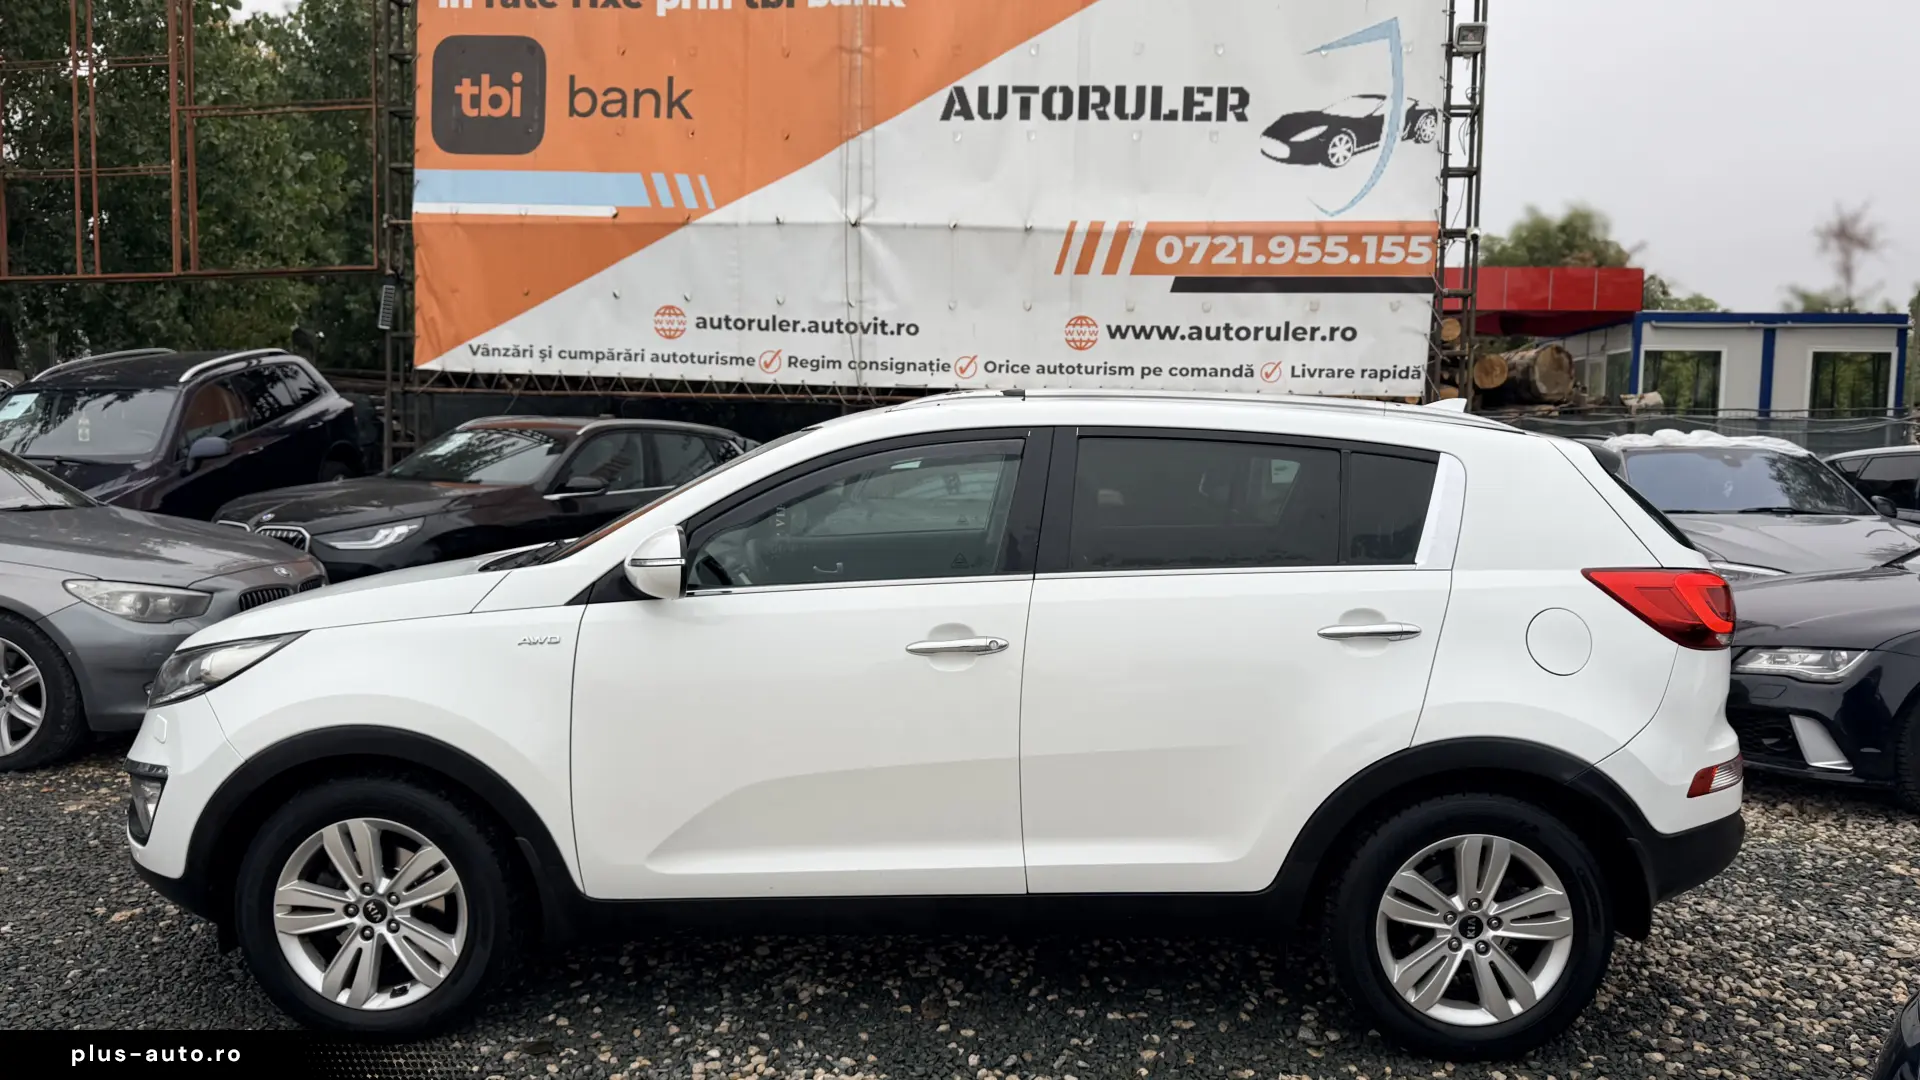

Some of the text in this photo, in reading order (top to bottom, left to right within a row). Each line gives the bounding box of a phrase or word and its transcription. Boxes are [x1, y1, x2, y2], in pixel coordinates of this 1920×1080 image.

[454, 71, 694, 120] tbi bank
[940, 85, 1251, 122] AUTORULER
[1155, 235, 1433, 265] 0721.955.155
[695, 314, 920, 337] autoruler.autovit.ro
[1106, 321, 1358, 342] www.autoruler.ro
[468, 343, 755, 366] Vânzări și cumpărări autoturisme
[787, 355, 951, 376] Regim consignație
[984, 360, 1254, 379] Orice autoturism pe comandă
[1290, 364, 1422, 382] Livrare rapidă
[517, 635, 561, 646] AWD
